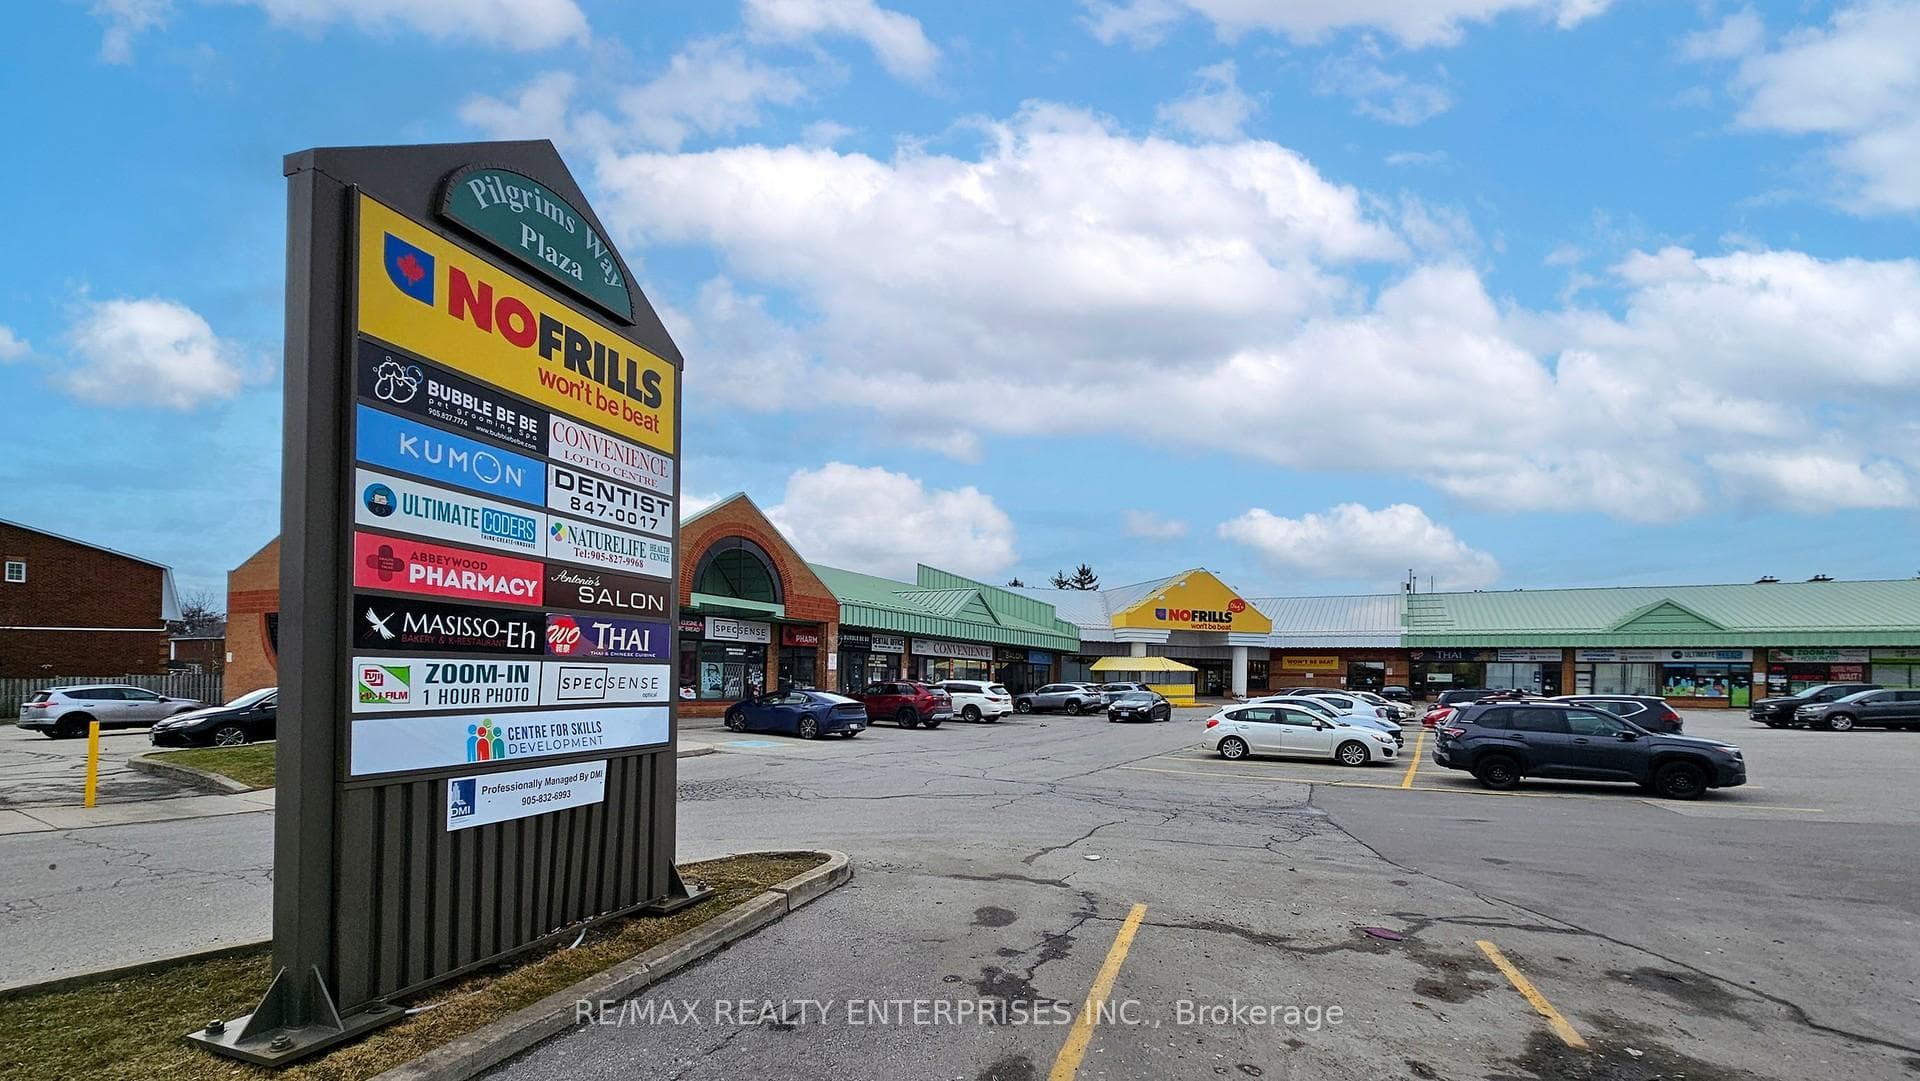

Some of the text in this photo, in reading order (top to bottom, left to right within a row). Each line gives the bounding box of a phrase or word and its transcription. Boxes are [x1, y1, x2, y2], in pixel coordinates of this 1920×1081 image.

[466, 175, 622, 288] Pilgrims Way
[519, 221, 583, 281] Plaza
[428, 379, 538, 434] BUBBLE BE BE
[538, 366, 660, 433] won't be beat
[428, 398, 449, 410] pet
[457, 408, 513, 434] grooming
[399, 431, 523, 487] KUMON
[553, 421, 669, 478] CONVENIENCE
[564, 450, 658, 488] LOTTO CENTRE
[555, 469, 670, 518] DENTIST
[403, 492, 535, 541] ULTIMATE CODERS
[570, 496, 658, 530] 847-0017
[568, 525, 647, 559] NATURELIFE
[649, 543, 670, 554] HEALTH
[410, 551, 488, 571] ABBEYWOOD
[573, 547, 644, 568] Tel:905-827-9968
[649, 552, 669, 564] CENTRE
[409, 563, 538, 597] PHARMACY
[551, 569, 600, 587] Antonio's
[578, 586, 664, 612] SALON
[401, 634, 506, 648] BAKERY & K-RESTAURANT
[402, 611, 536, 649] MASISSO-Eh
[933, 642, 991, 658] CONVENIENCE
[1435, 650, 1462, 659] THAI
[425, 663, 530, 684] ZOOM-IN
[423, 687, 529, 705] 1 HOUR PHOTO
[508, 720, 602, 741] CENTRE FOR SKILLS
[508, 735, 603, 755] DEVELOPMENT
[481, 769, 603, 795] Professionally Managed By DMI
[521, 789, 571, 806] 905-832-6993
[451, 805, 471, 817] DMI
